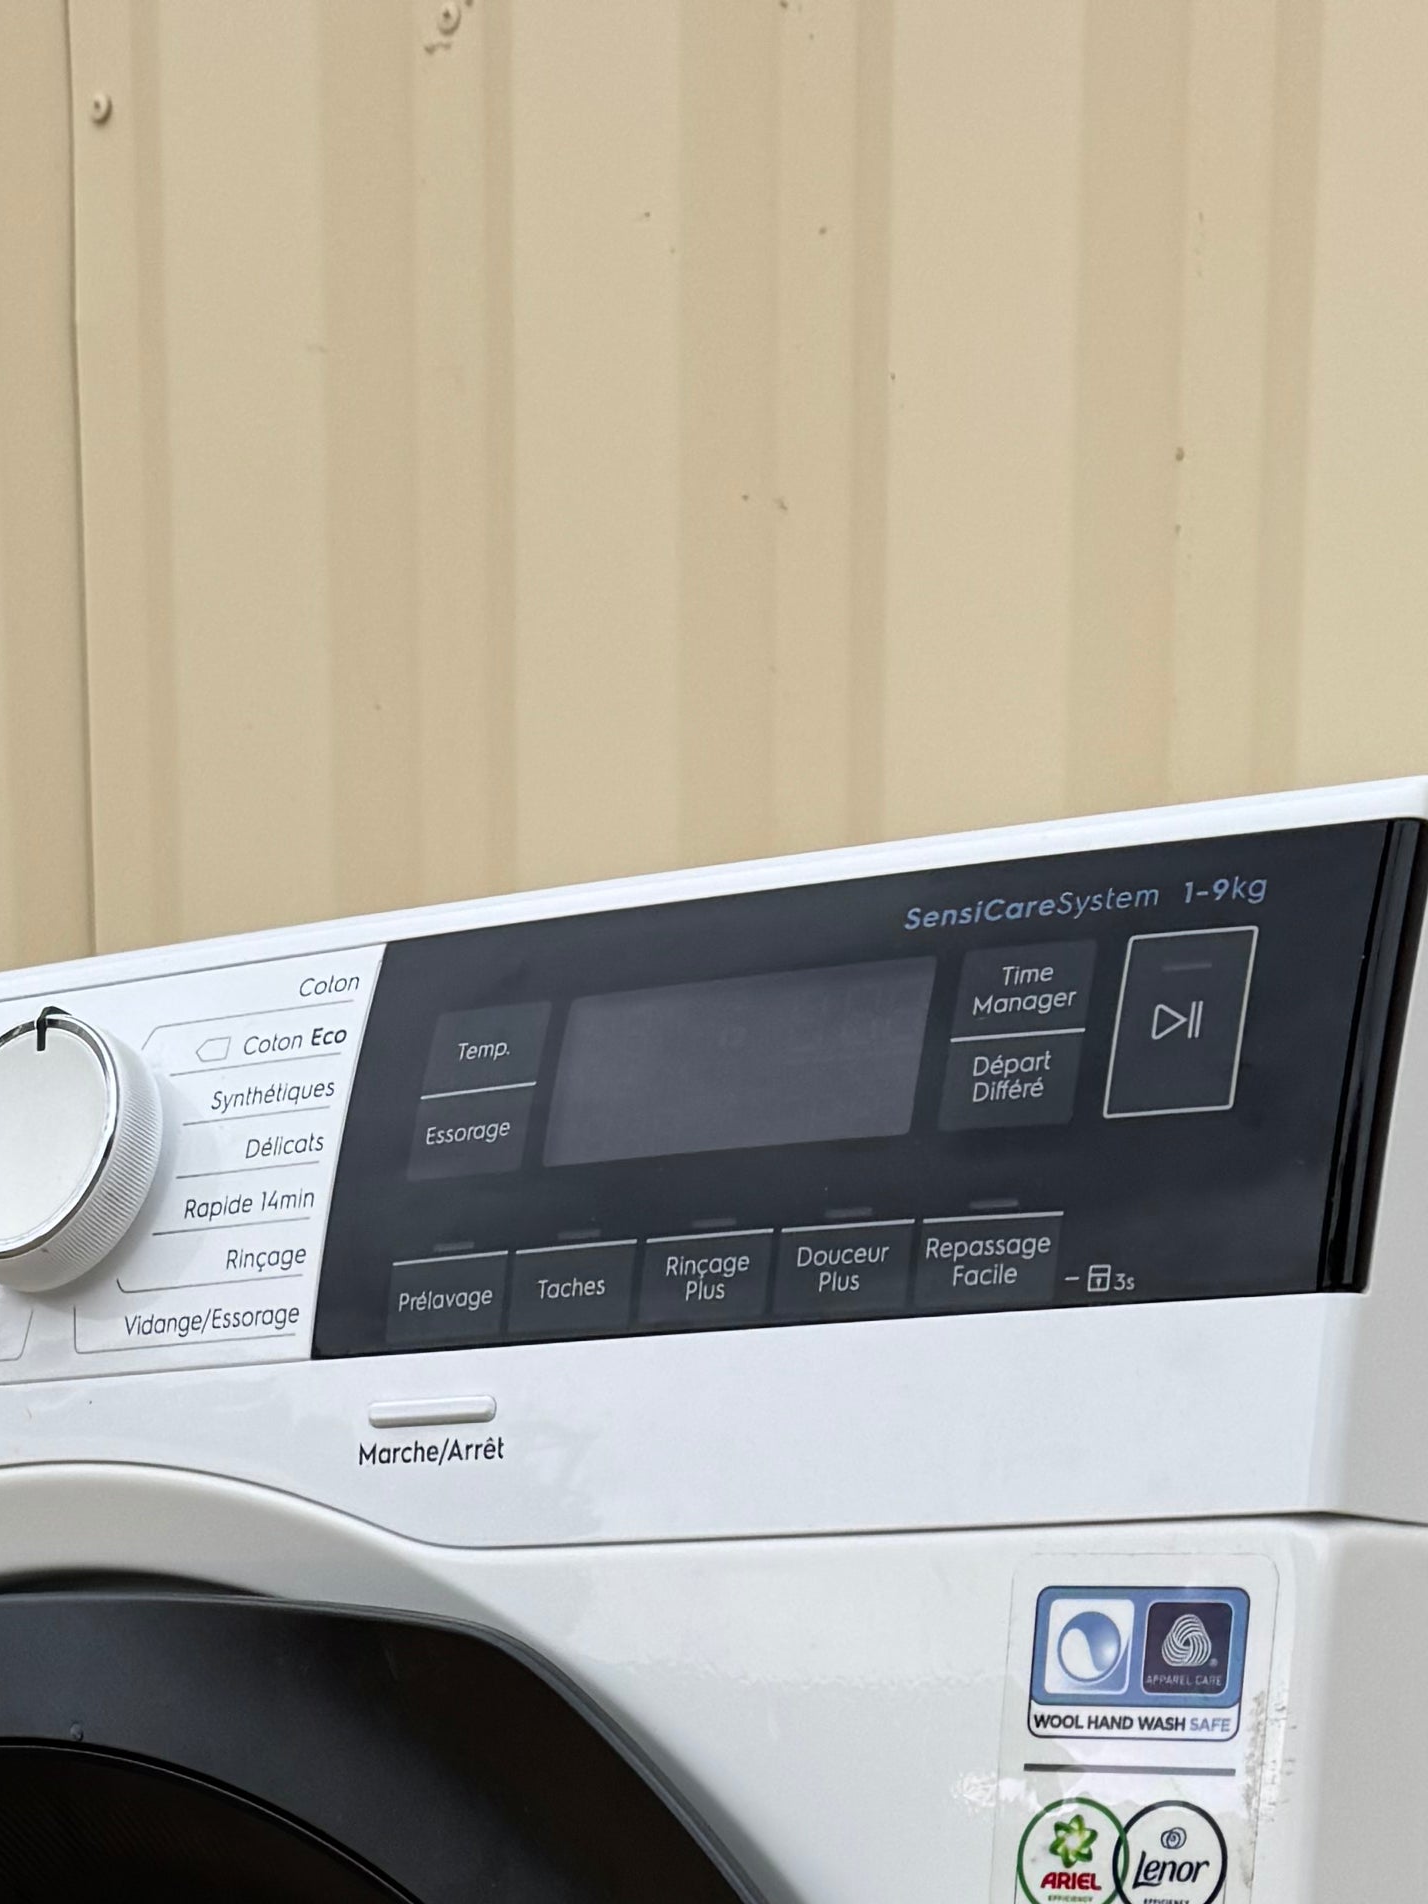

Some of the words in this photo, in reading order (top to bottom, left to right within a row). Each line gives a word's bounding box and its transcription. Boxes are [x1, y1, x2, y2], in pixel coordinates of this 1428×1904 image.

[903, 885, 1160, 931] SensiCareSystem
[1182, 874, 1269, 904] 1-9kg
[1002, 964, 1055, 987] Time
[972, 987, 1078, 1017] Manager
[310, 1025, 349, 1049] Eco
[458, 1038, 512, 1062] Temp.
[972, 1049, 1053, 1082] Départ
[211, 1078, 337, 1112] Synthétiques
[972, 1076, 1046, 1103] Différé
[244, 1132, 326, 1160] Délicats
[425, 1118, 512, 1147] Essorage
[184, 1196, 255, 1222] Rapide
[261, 1189, 316, 1212] 14min
[225, 1245, 308, 1274] Rinçage
[796, 1243, 891, 1268] Douceur
[924, 1233, 1053, 1262] Repassage
[665, 1253, 751, 1283] Rinçage
[817, 1269, 862, 1293] Plus
[952, 1263, 1019, 1287] Facile
[1113, 1270, 1136, 1292] 3s
[398, 1286, 494, 1314] Prélavage
[538, 1276, 607, 1300] Taches
[684, 1278, 727, 1301] Plus
[124, 1303, 301, 1338] Vidange/Essorage
[358, 1436, 506, 1466] Marche/Arrêt
[1146, 1674, 1191, 1687] APPAREL
[1195, 1675, 1222, 1688] CARE
[1034, 1713, 1085, 1731] WOOL
[1087, 1714, 1135, 1731] HAND
[1138, 1716, 1187, 1733] WASH
[1189, 1717, 1233, 1733] SAFE
[1040, 1872, 1103, 1892] ARIEL
[1132, 1850, 1210, 1890] Lenor
